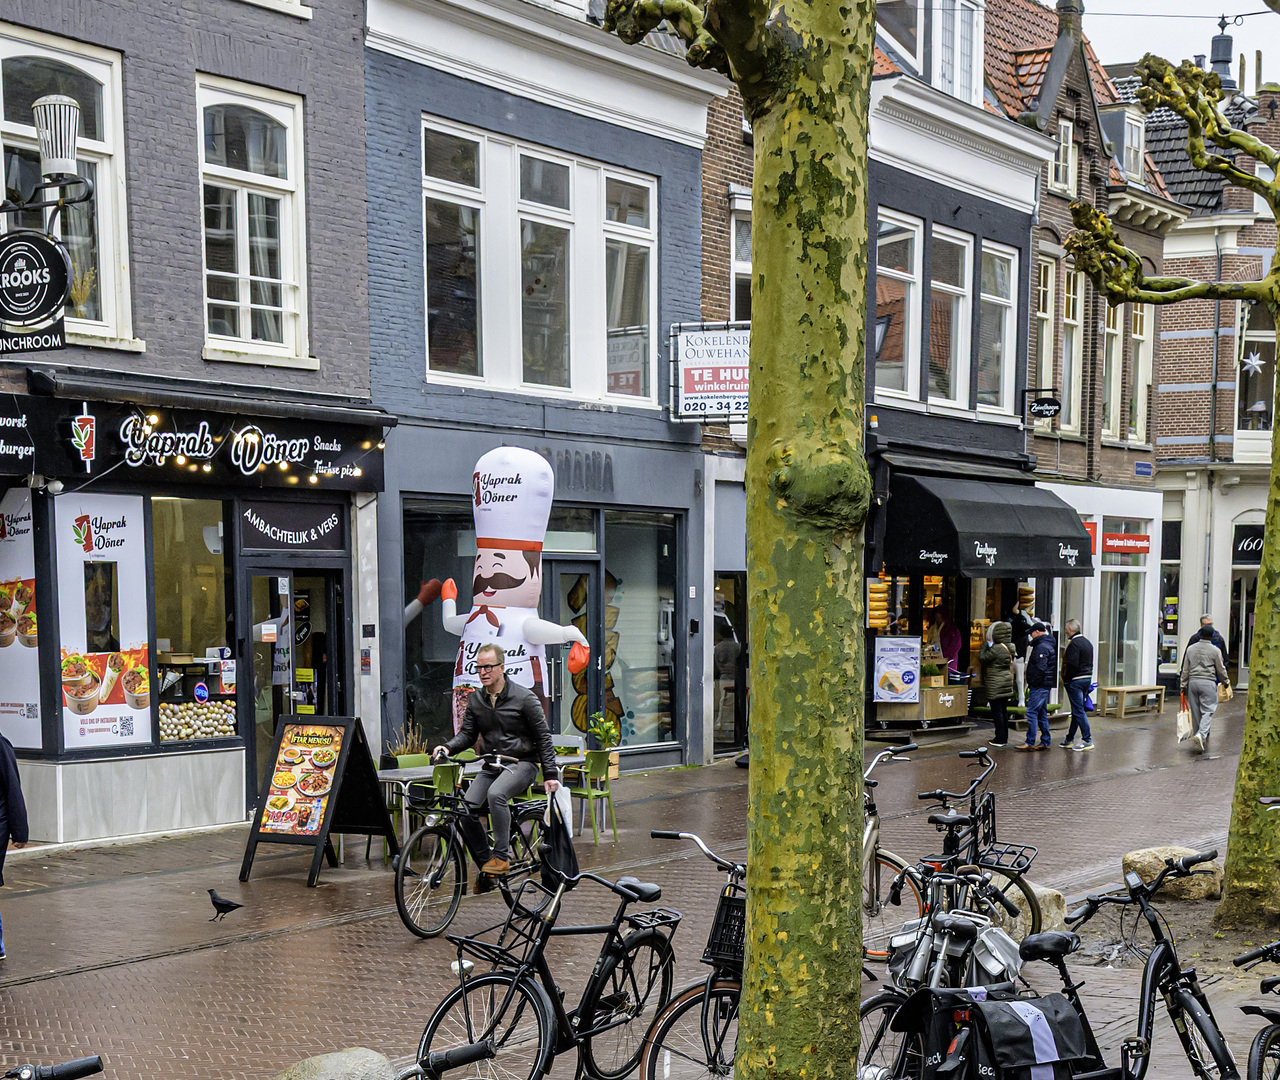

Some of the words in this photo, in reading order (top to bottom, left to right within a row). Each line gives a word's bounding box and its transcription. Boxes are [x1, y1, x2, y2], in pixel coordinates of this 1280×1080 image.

[691, 369, 712, 382] TE
[684, 402, 706, 412] 020
[716, 402, 730, 411] 34
[120, 414, 214, 467] Yaprak
[314, 436, 342, 452] Snacks
[232, 425, 310, 476] Döner
[340, 462, 362, 478] piz
[480, 472, 522, 490] Yaprak
[482, 490, 518, 504] Döner
[6, 512, 32, 526] Yaprak
[92, 516, 126, 534] Yaprak
[244, 508, 309, 544] AMBACHTELIJK
[310, 528, 318, 540] &
[318, 514, 338, 536] VERS
[8, 526, 30, 537] Döner
[94, 535, 125, 550] Döner
[1238, 536, 1264, 552] 160
[465, 642, 527, 660] Yak
[270, 810, 298, 822] 19,90
